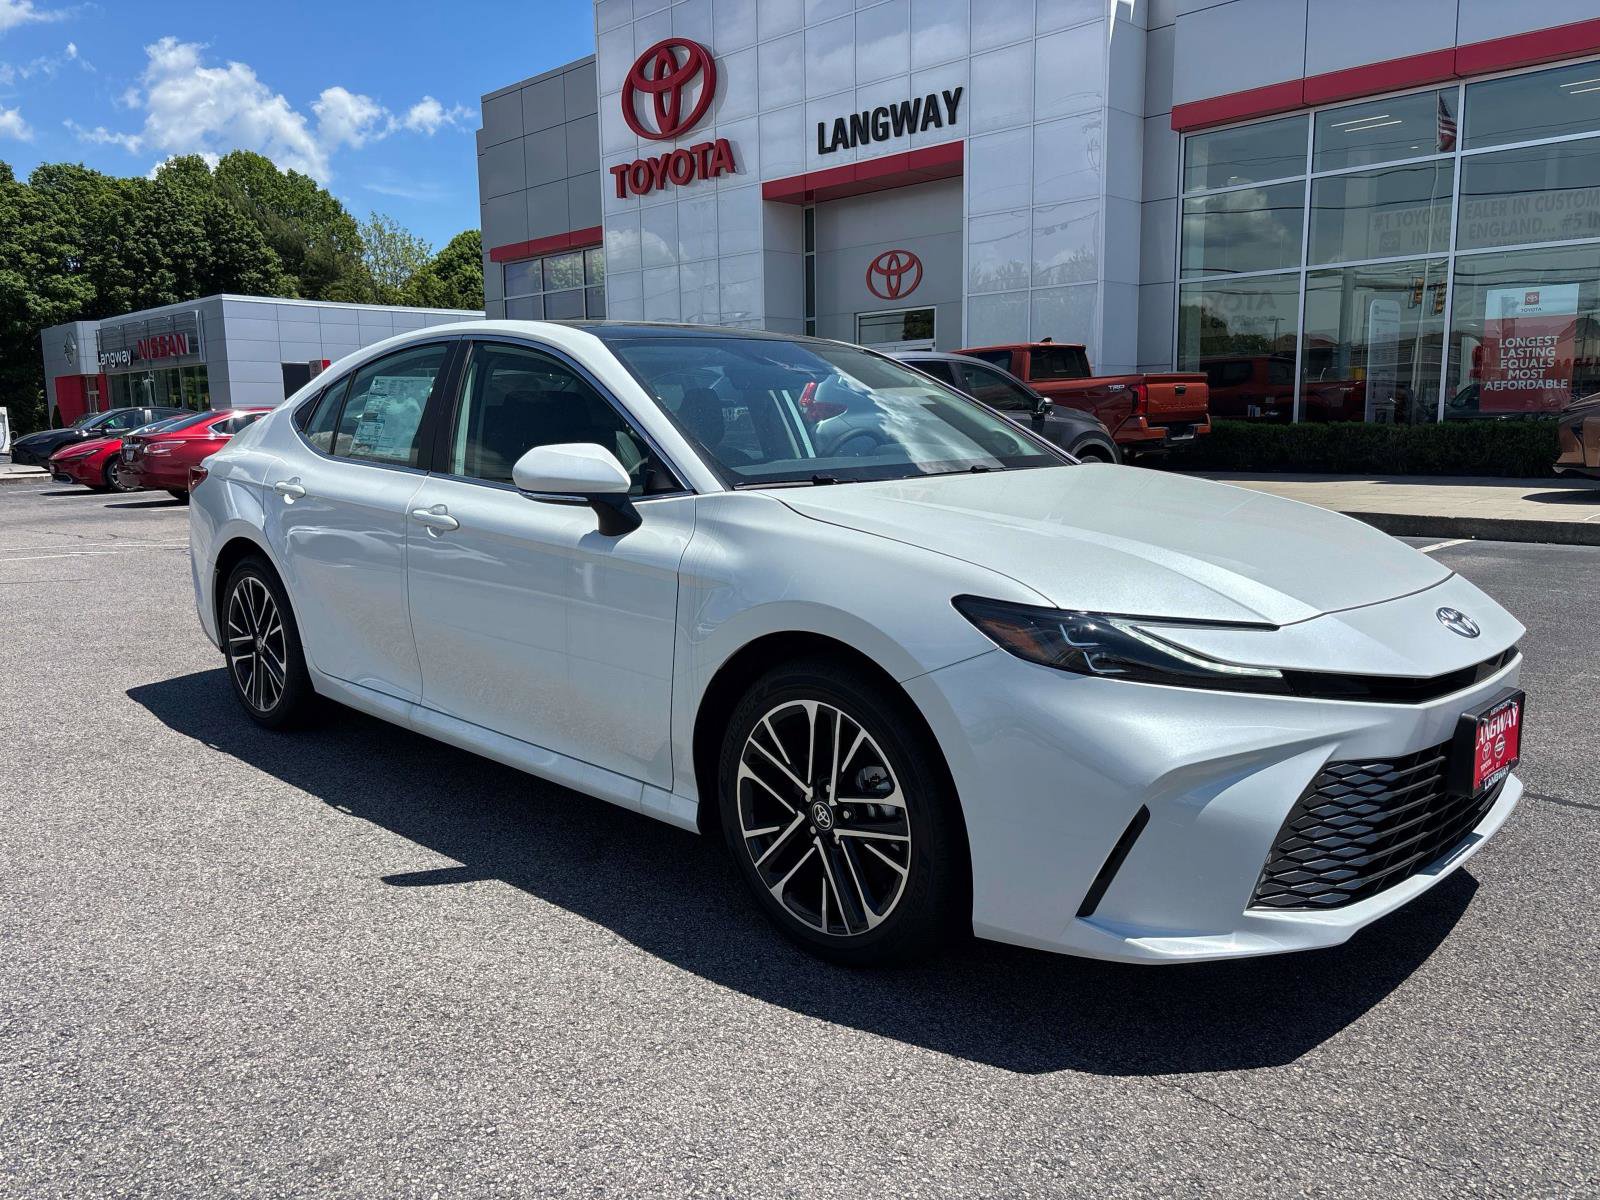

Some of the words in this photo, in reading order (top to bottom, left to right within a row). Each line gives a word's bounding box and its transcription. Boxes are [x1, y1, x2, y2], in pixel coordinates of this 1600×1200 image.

[817, 86, 964, 155] LANGWAY
[610, 138, 736, 199] TOYOTA
[1374, 214, 1390, 231] #1
[1395, 209, 1449, 228] TOYOTA
[1464, 200, 1509, 219] EALER
[1512, 199, 1529, 214] IN
[1432, 228, 1450, 246] NE
[1499, 336, 1559, 348] LONGEST
[97, 349, 133, 368] Langway
[137, 333, 188, 360] NISSAN
[1500, 347, 1556, 358] LASTING
[1500, 358, 1555, 369] EQUALS
[1507, 369, 1546, 379] MOST
[1108, 384, 1125, 392] TRD
[1484, 379, 1568, 391] AFFORDABLE
